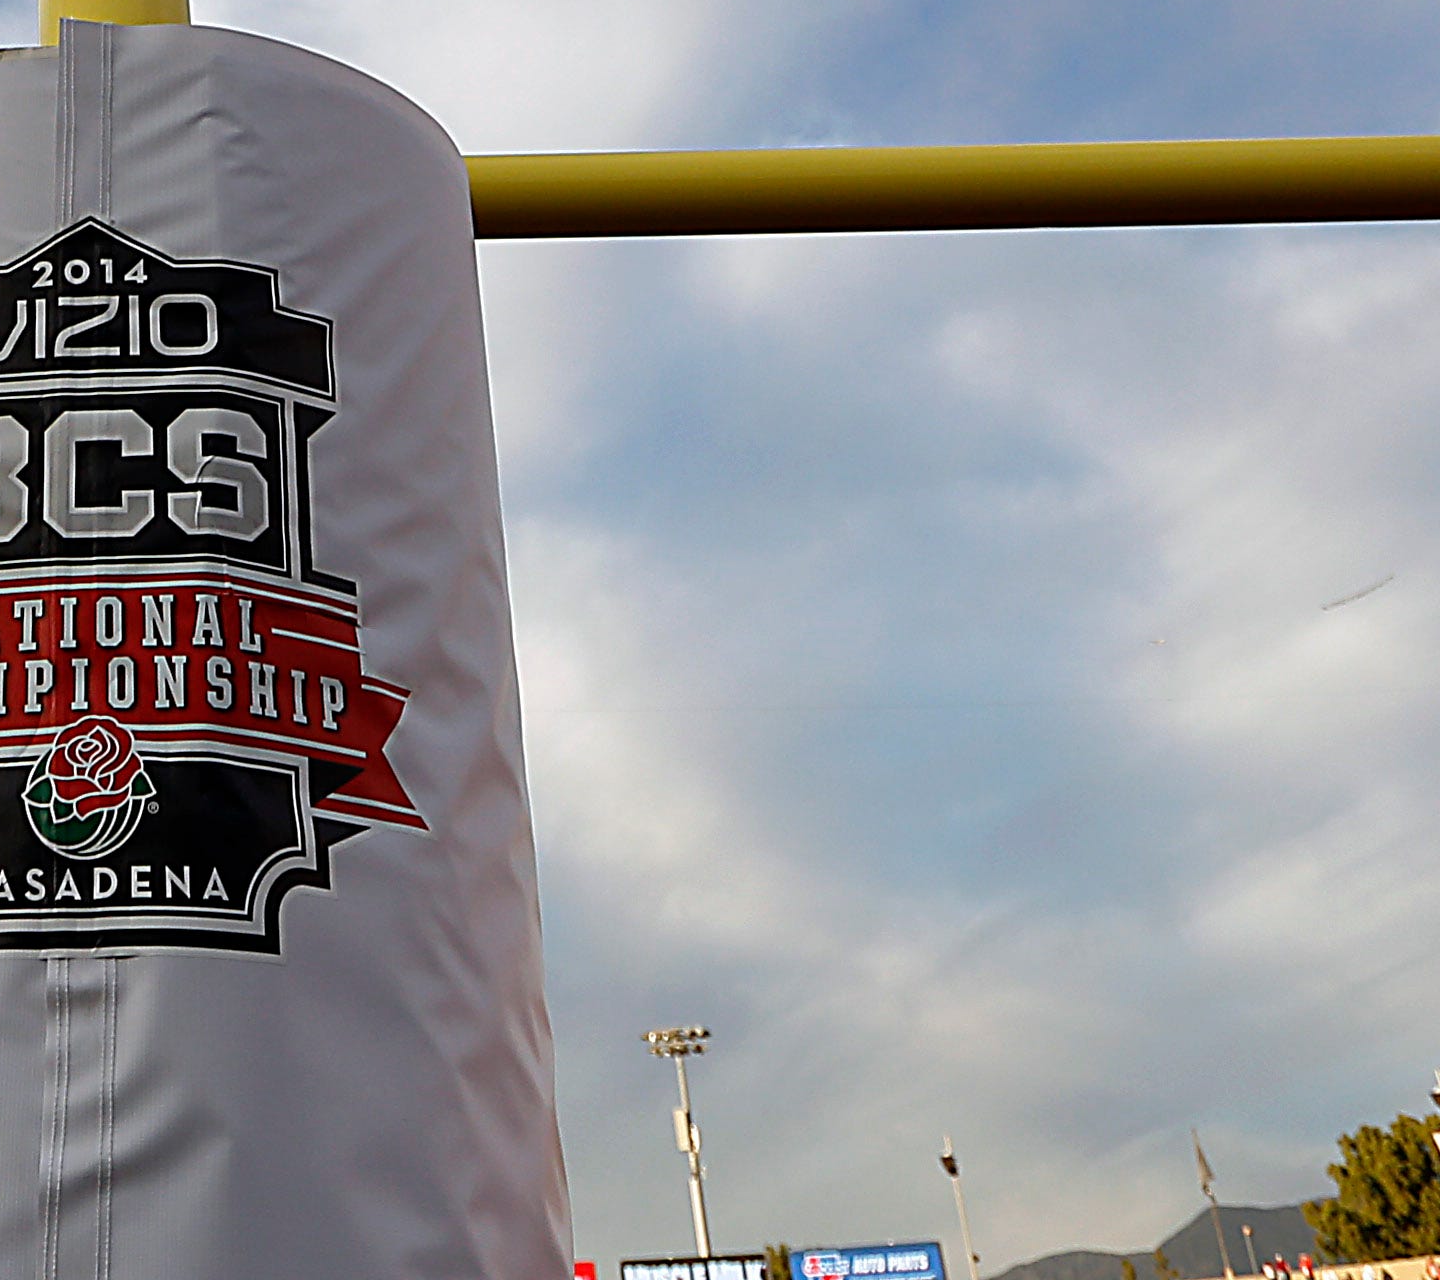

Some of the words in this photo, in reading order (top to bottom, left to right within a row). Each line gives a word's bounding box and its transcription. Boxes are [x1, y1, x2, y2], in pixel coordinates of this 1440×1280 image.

[31, 259, 149, 286] 2014
[852, 1252, 887, 1274] AUTO
[887, 1250, 929, 1272] PARTS
